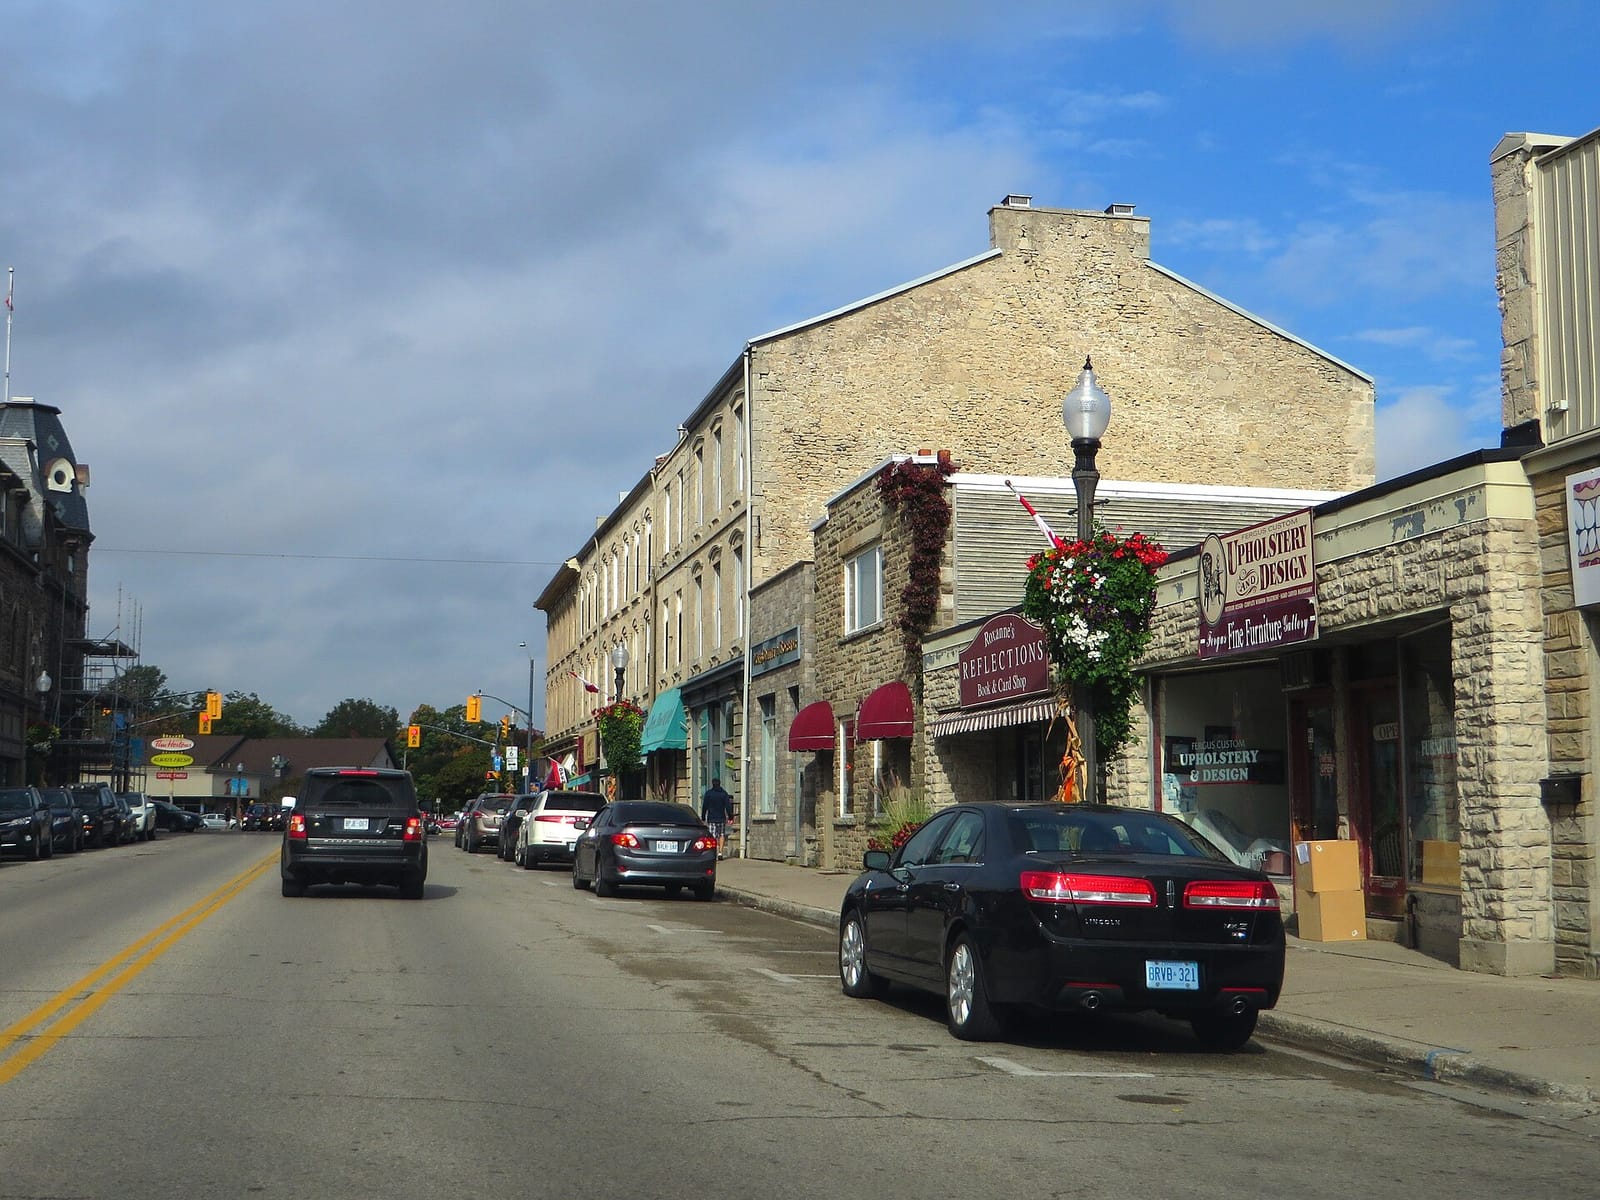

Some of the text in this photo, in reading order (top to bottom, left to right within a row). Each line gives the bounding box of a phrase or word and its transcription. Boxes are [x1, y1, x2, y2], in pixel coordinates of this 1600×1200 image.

[1241, 518, 1298, 540] FERGUS CUSTOM
[1227, 525, 1307, 575] UPHOLSTERY
[1239, 554, 1307, 592] AND DESIGN
[984, 622, 1015, 647] Roxanne's
[1227, 621, 1244, 649] Fine
[1245, 614, 1282, 647] Furniture
[962, 640, 1043, 680] REFLECTIONS
[977, 674, 1027, 697] Book & Card Shop
[1379, 724, 1398, 739] OPE
[1191, 739, 1246, 750] FERGUS CUSTOM
[1421, 737, 1457, 756] FURNITUR
[1180, 750, 1259, 766] UPHOLSTERY
[1190, 767, 1249, 782] & DESIGN
[1084, 917, 1121, 926] LINCOLN
